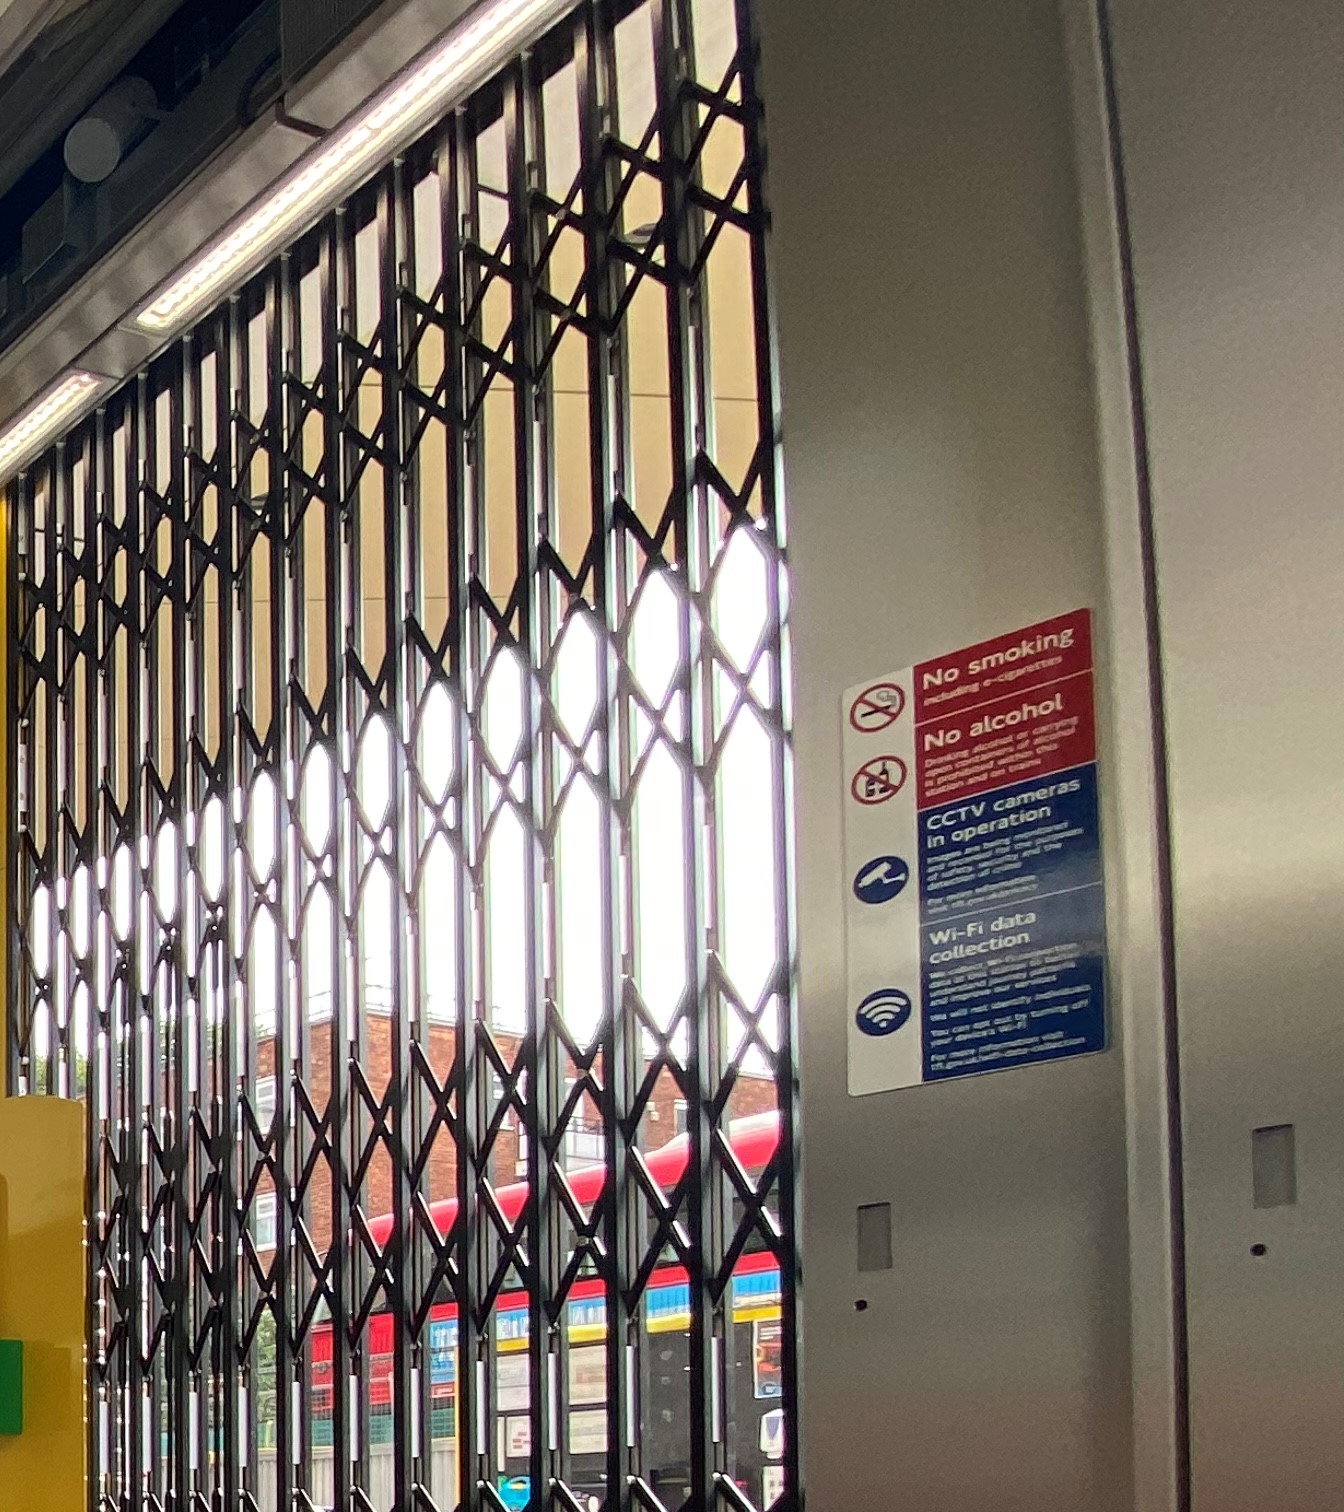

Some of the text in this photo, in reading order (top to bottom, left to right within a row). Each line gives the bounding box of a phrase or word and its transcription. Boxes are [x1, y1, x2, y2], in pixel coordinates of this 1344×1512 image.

[923, 628, 1075, 690] No smoking
[924, 693, 1063, 751] No alcohol
[926, 779, 1081, 830] CCTV cameras
[927, 805, 1051, 849] in operation
[929, 912, 1036, 945] Wi-Fi data
[929, 932, 1031, 964] collection
